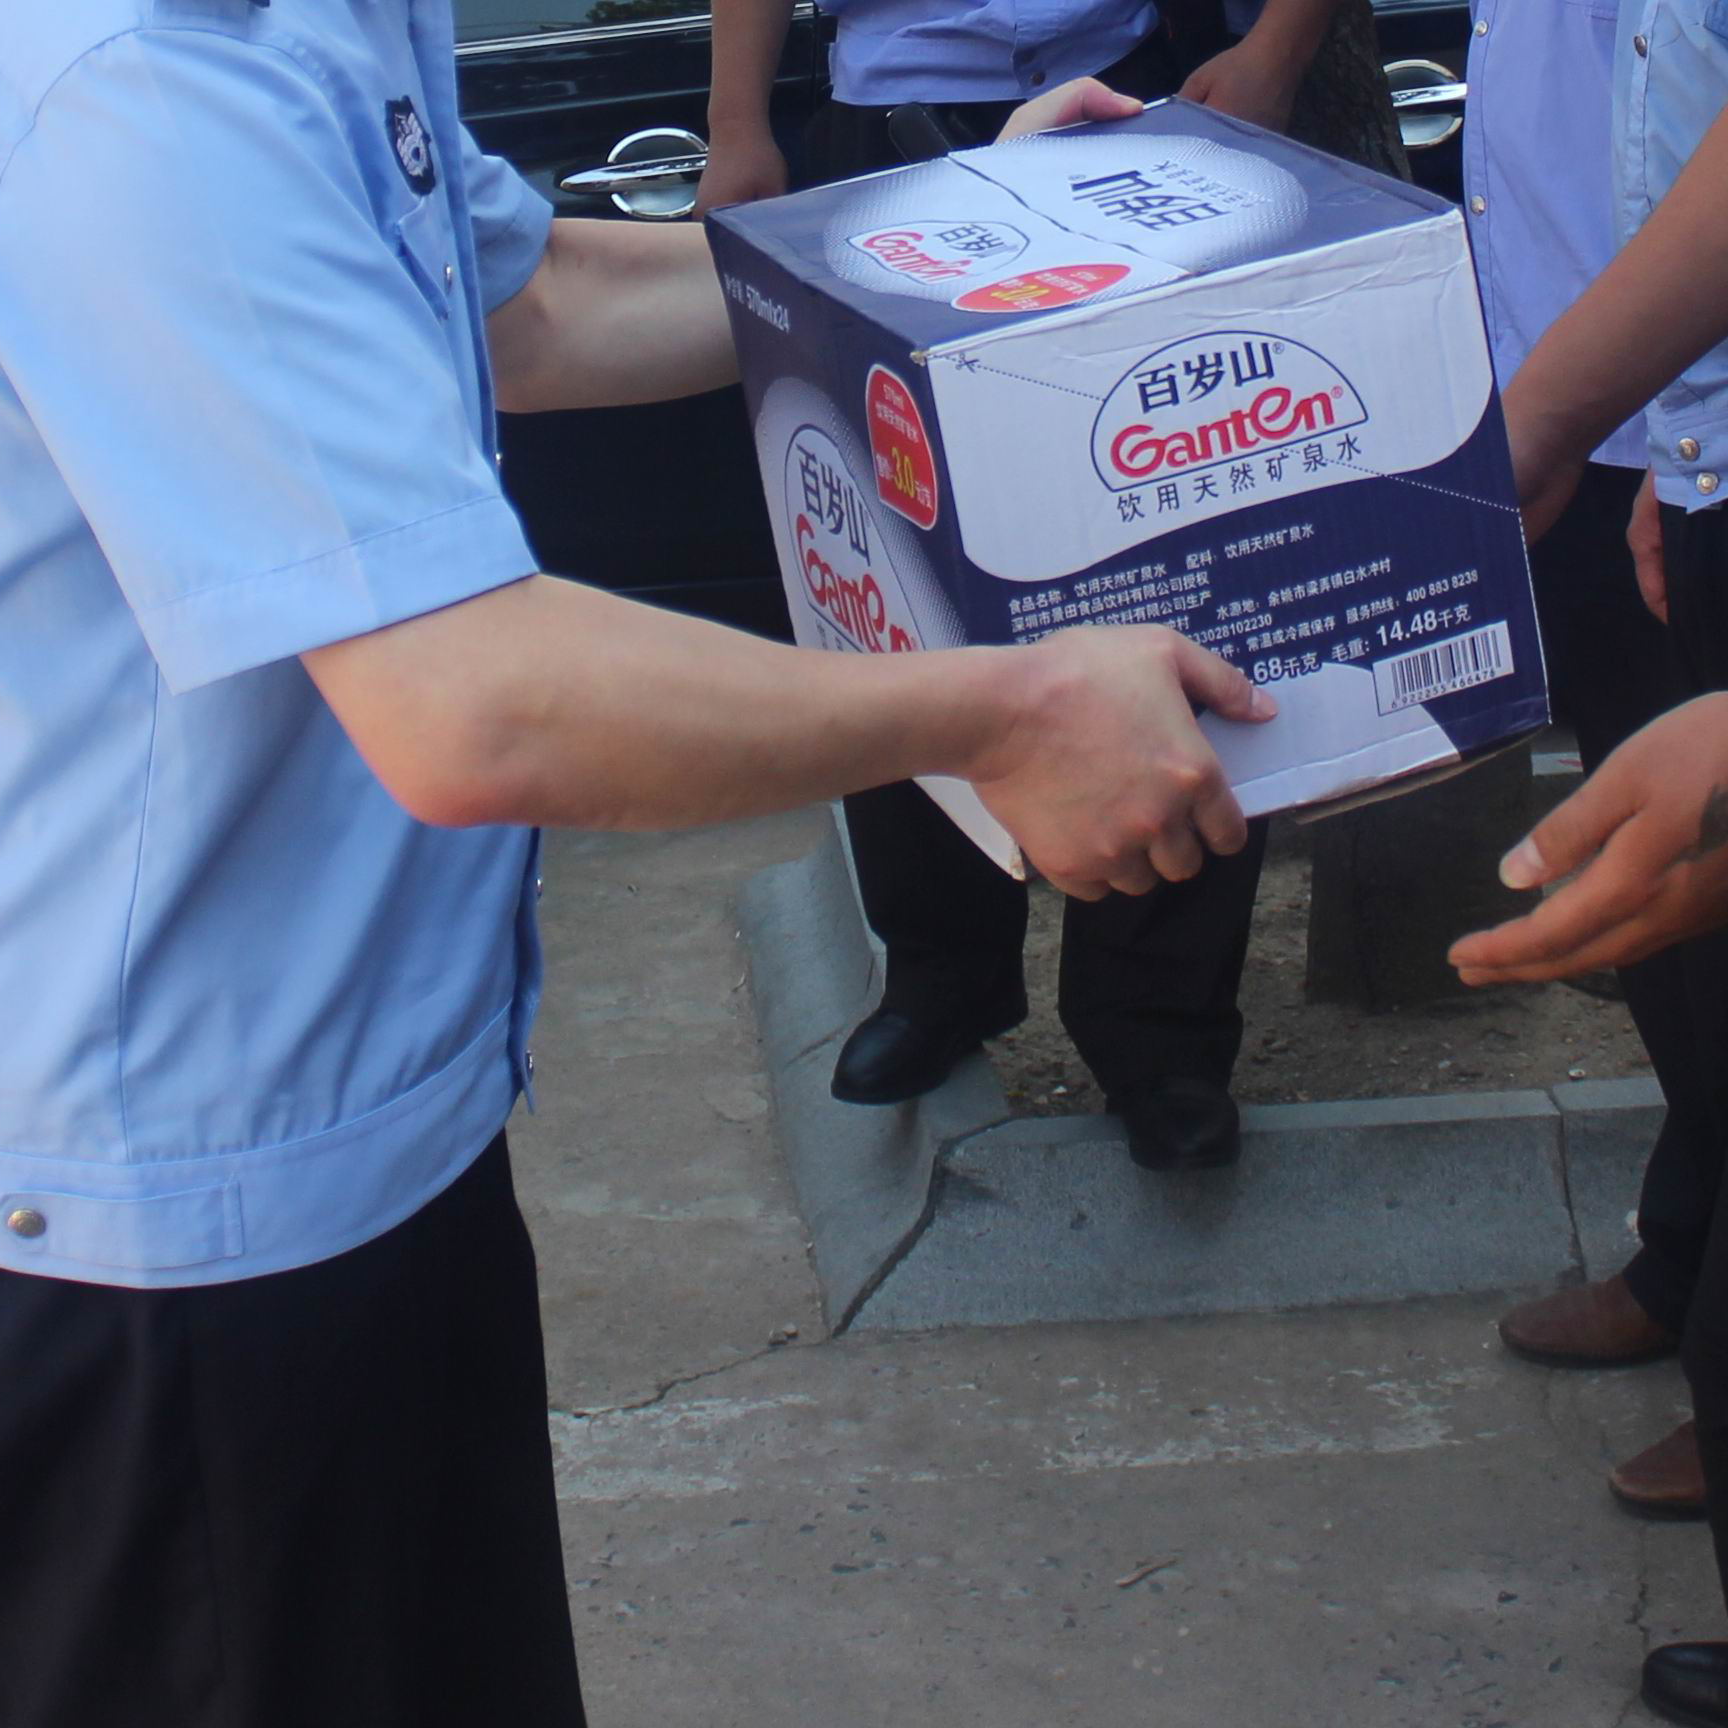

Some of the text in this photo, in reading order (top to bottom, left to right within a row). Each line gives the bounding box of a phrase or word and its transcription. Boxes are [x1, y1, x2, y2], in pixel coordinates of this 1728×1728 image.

[1137, 340, 1275, 410] 百岁山
[1109, 384, 1337, 481] Ganten
[1116, 433, 1362, 525] 饮用天然矿泉水
